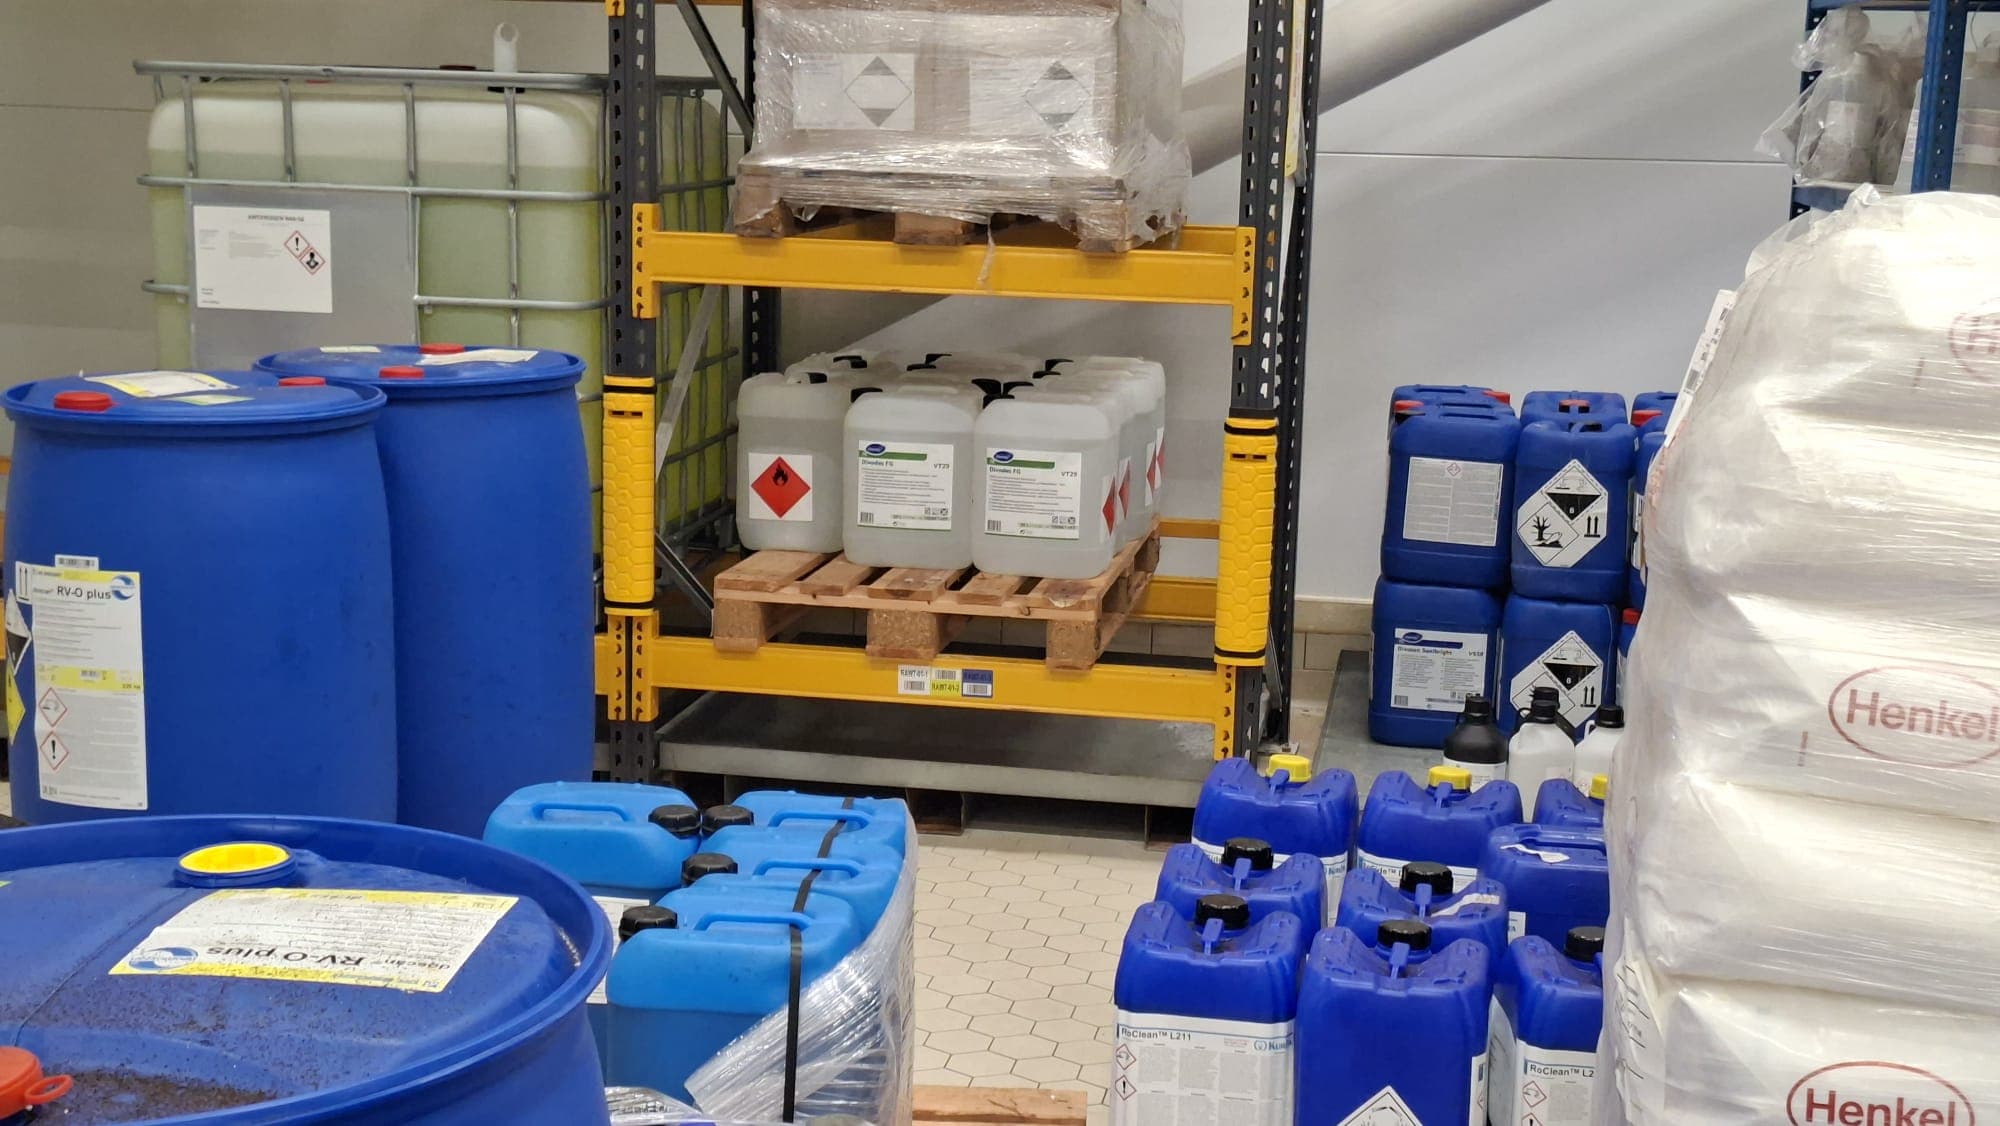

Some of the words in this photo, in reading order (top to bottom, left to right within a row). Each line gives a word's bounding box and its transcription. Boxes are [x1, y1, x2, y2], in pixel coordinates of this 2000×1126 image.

[57, 585, 83, 598] RV-O
[87, 589, 111, 600] plus
[1847, 689, 1999, 742] Henkel
[207, 943, 276, 961] plus
[282, 948, 364, 967] RV-O
[1170, 1031, 1191, 1041] L211
[1530, 1064, 1580, 1077] RoClean™
[1806, 1088, 1956, 1126] Henkel
